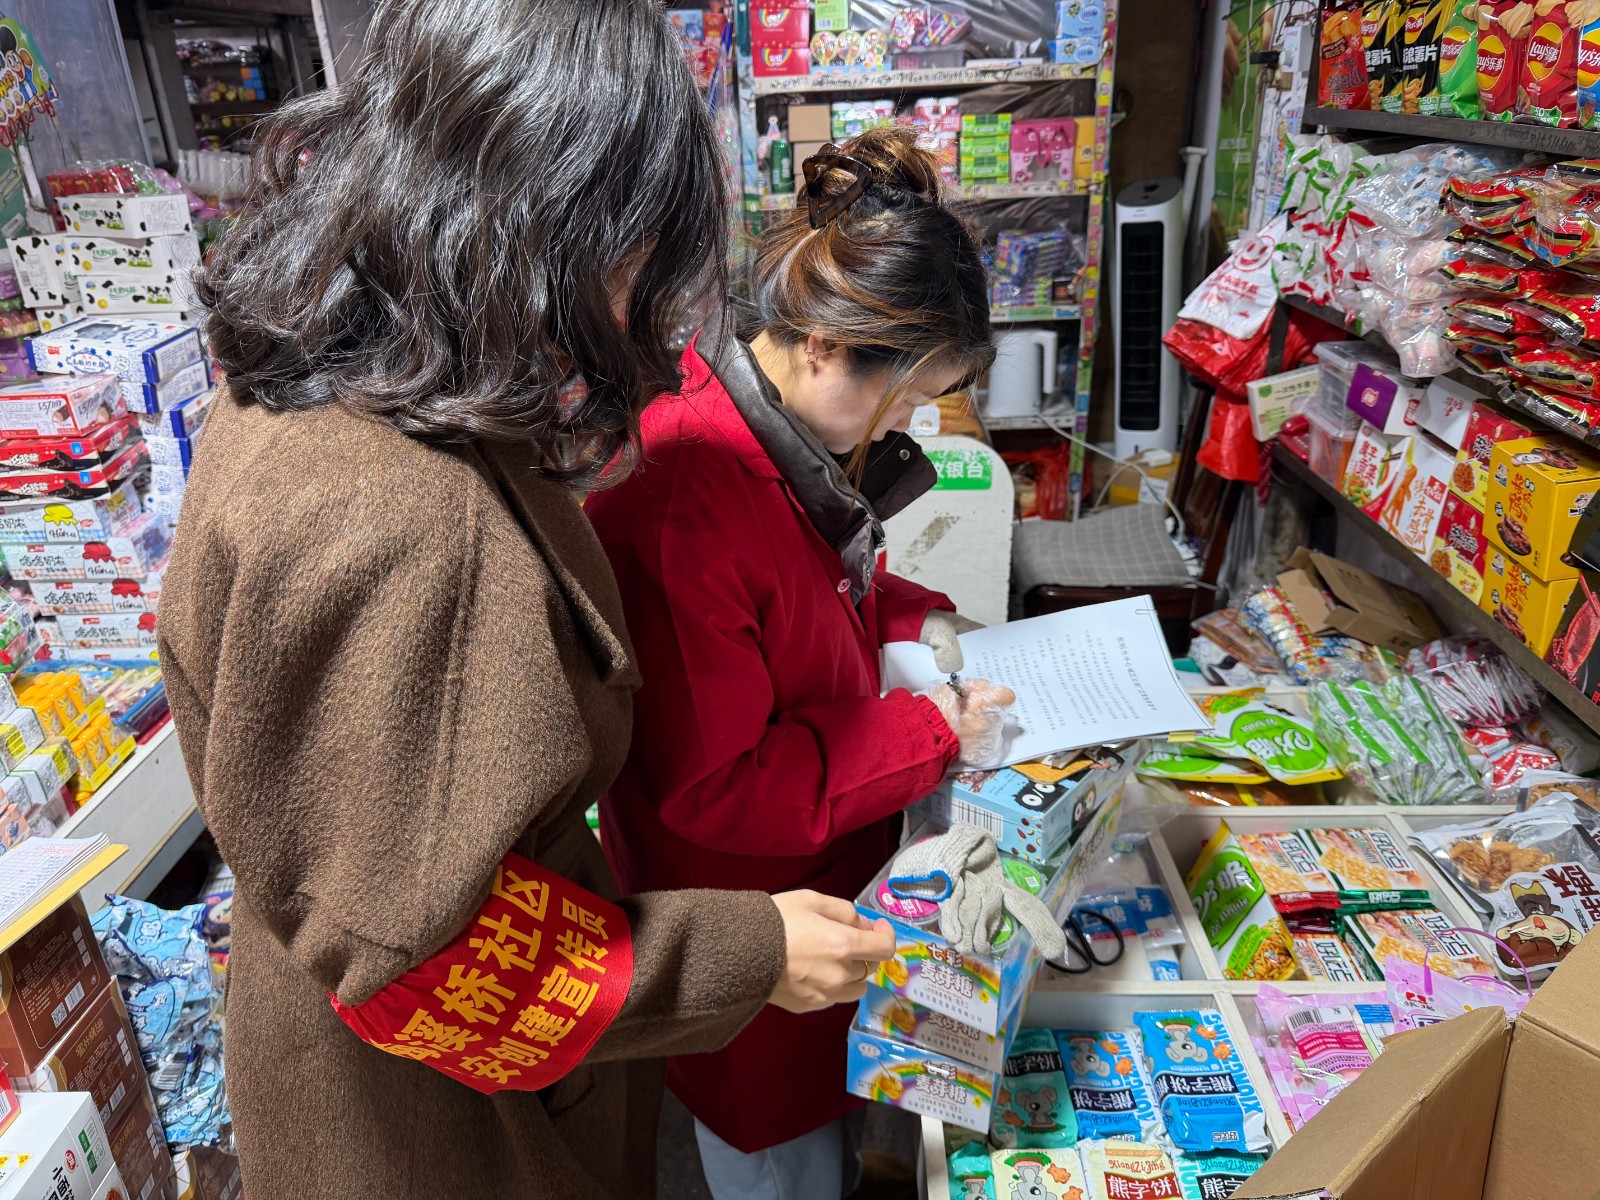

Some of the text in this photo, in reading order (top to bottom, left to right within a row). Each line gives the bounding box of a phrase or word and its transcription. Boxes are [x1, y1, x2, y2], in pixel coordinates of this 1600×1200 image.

[445, 896, 608, 1084] 安创建宣传员
[920, 958, 974, 999] 麦芽糖
[915, 1073, 968, 1105] 麦芽糖
